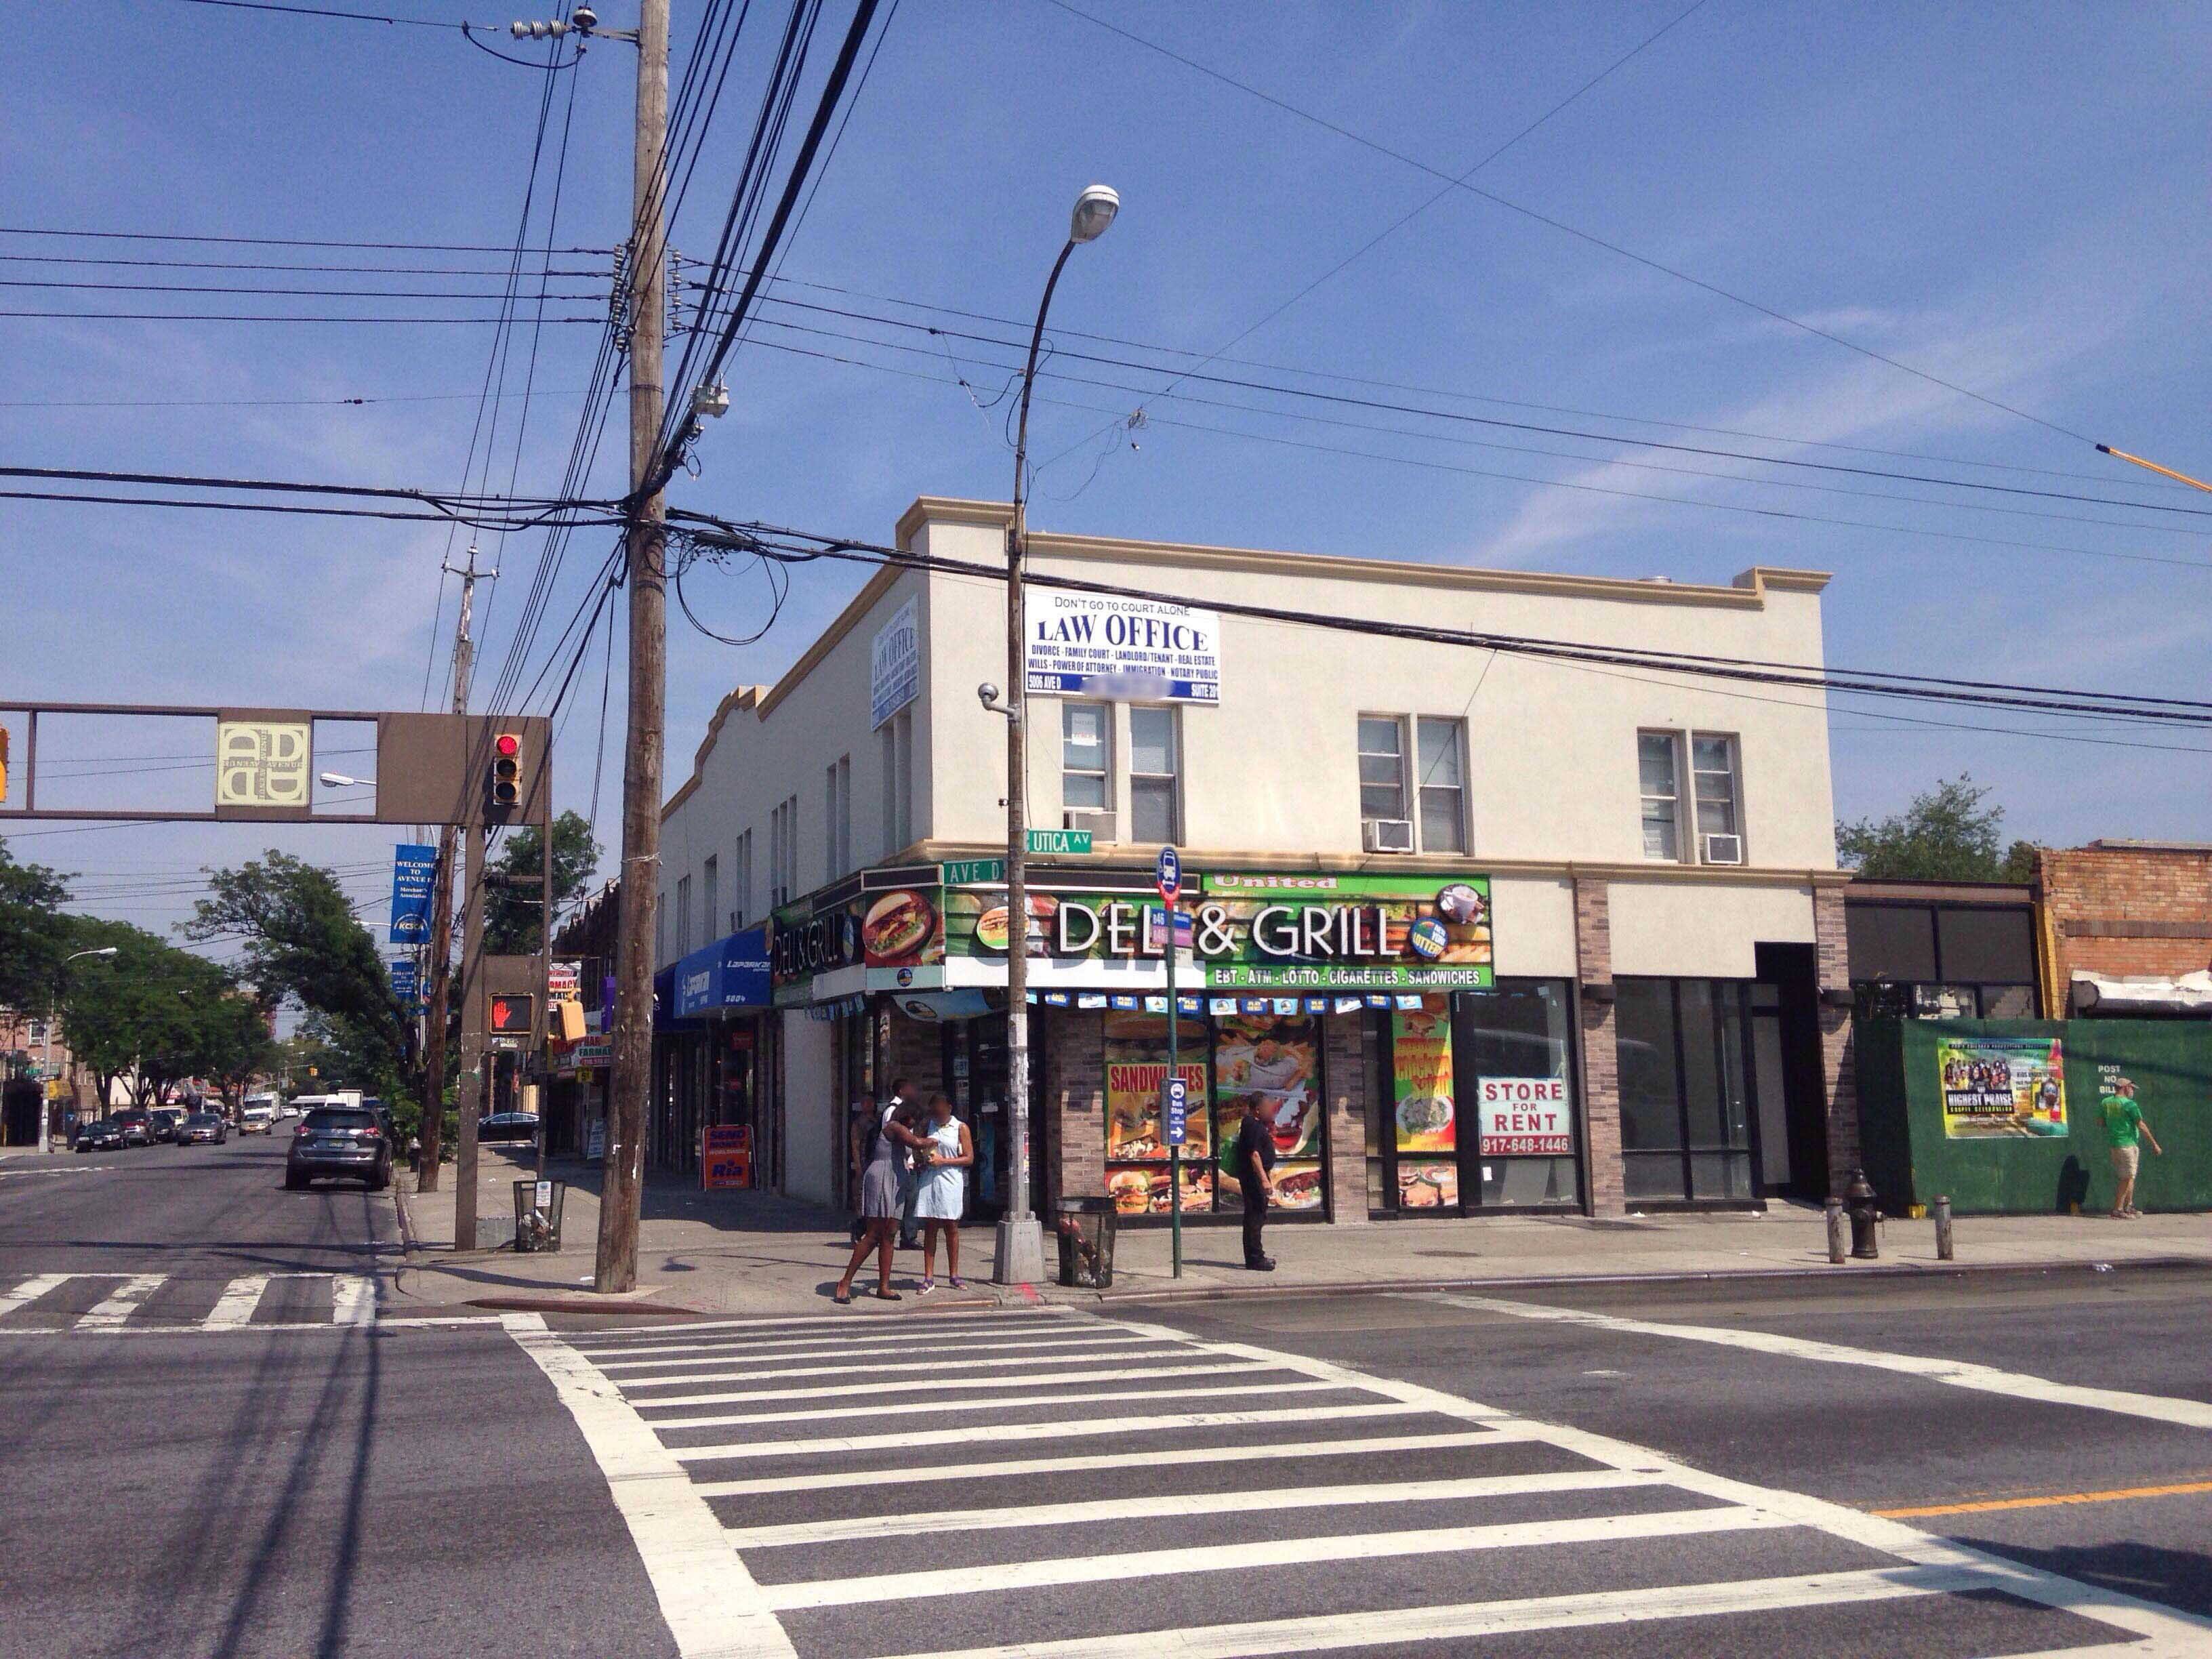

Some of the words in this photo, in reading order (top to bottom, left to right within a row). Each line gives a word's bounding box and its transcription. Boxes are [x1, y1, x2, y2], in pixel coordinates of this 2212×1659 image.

[1089, 601, 1104, 610] GO
[1106, 602, 1119, 611] TO
[1122, 603, 1154, 613] COURT
[1157, 605, 1190, 616] ALONE
[1038, 614, 1097, 644] LAW
[1105, 614, 1208, 651] OFFICE
[1031, 644, 1060, 656] DIVORCE
[1065, 647, 1086, 658] FAMILY
[1088, 649, 1109, 659] COURT
[1179, 655, 1192, 665] REAL
[1194, 655, 1215, 666] ESTATE
[1028, 658, 1048, 670] WILLS
[1053, 660, 1076, 671] POWER
[1077, 661, 1084, 672] OF
[1086, 661, 1117, 673] ATTORNEY
[1170, 668, 1194, 678] NOTARY
[1196, 669, 1218, 680] PUBLIC
[1044, 676, 1057, 689] AVE
[1191, 683, 1210, 698] SUITE
[1033, 832, 1069, 852] UTICA
[1073, 834, 1090, 844] AV
[950, 863, 980, 882] AVE
[991, 861, 1000, 880] D
[1213, 874, 1339, 889] United
[1059, 902, 1179, 954] DEL
[1197, 905, 1241, 956] &
[1252, 906, 1401, 956] GRILL
[1214, 969, 1237, 985] EBT
[1248, 969, 1272, 985] ATM
[1282, 969, 1319, 985] LOTTO
[1329, 969, 1399, 985] CIGARETTES
[1408, 969, 1480, 985] SANDWICHES
[2098, 1065, 2121, 1073] POST
[1111, 1065, 1204, 1092] SANDWIHES
[2104, 1075, 2116, 1083] NO
[1485, 1083, 1563, 1101] STORE
[2099, 1086, 2116, 1094] BILL
[1513, 1103, 1537, 1111] FOR
[1948, 1093, 1982, 1107] HIGHEST
[1985, 1093, 2012, 1107] PRAISE
[1170, 1107, 1185, 1115] Stop
[1494, 1113, 1557, 1132] RENT
[1482, 1138, 1568, 1152] 917-648-1446
